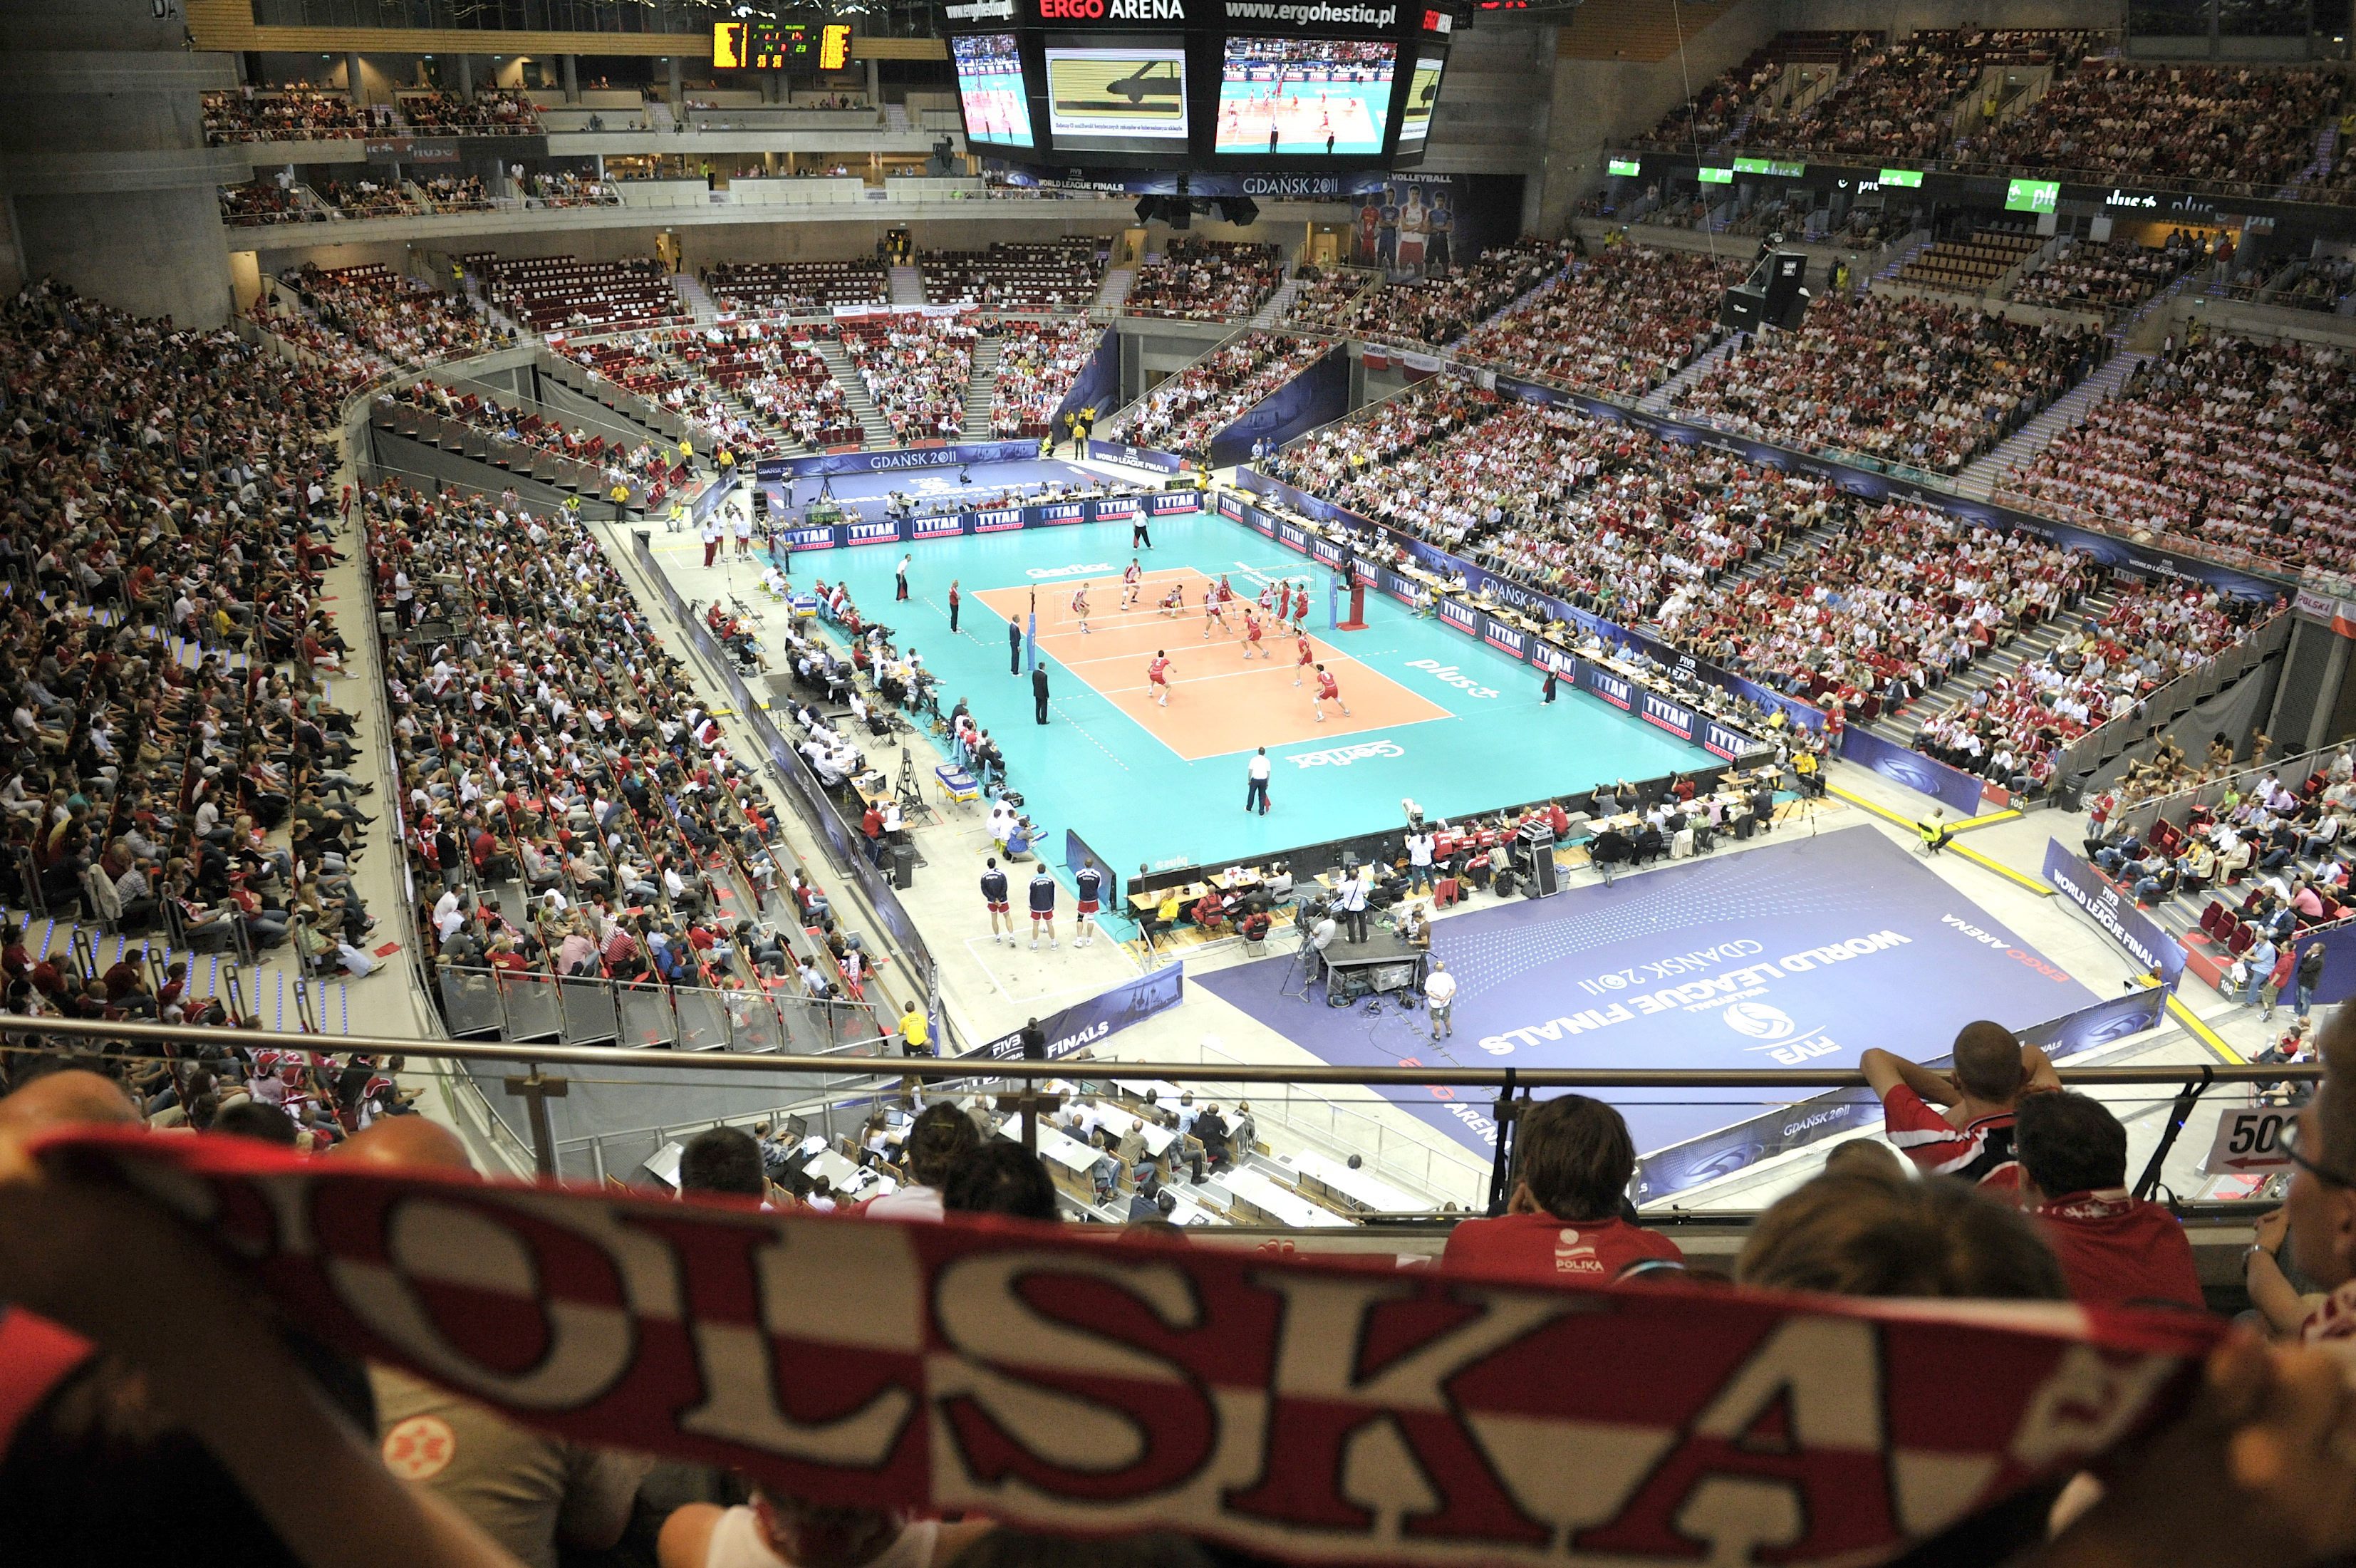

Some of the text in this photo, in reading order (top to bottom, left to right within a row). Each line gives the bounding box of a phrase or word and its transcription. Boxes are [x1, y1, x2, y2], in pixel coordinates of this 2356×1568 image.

[1040, 0, 1185, 19] ERGO ARENA
[1225, 1, 1397, 28] www.ergohestia.pl
[1038, 179, 1124, 192] WORLD LEAGUE FINALS
[1242, 175, 1339, 194] GDAŃSK 2011
[1391, 173, 1453, 183] VOLLEYBALL
[1445, 363, 1476, 378] SUBKOWY
[871, 451, 957, 469] GDAŃSK 2011
[1095, 452, 1169, 473] WORLD LEAGUE FINALS
[1100, 499, 1138, 514] TYTAN
[1156, 494, 1195, 509] TYTAN
[1221, 497, 1242, 517] TYTAN
[811, 514, 824, 523] 56
[916, 515, 959, 531] TYTAN
[978, 510, 1019, 526] TYTAN
[1040, 505, 1080, 520] TYTAN
[1252, 510, 1272, 531] TYTAN
[786, 529, 829, 544] TYTAN
[851, 521, 894, 539] TYTAN
[1282, 524, 1304, 546] TYTAN
[1315, 539, 1339, 562] TYTAN
[1354, 558, 1376, 580] YTAN
[2129, 559, 2152, 571] WORLD
[2152, 566, 2179, 578] LEAGUE
[2179, 573, 2204, 584] FINALS
[1443, 600, 1474, 625] TYTAN
[2298, 594, 2330, 613] POLSKA
[1488, 621, 1521, 649] TYTAN
[1536, 642, 1572, 674] TYN
[1679, 655, 1696, 668] FIVB
[1403, 658, 1477, 690] plus
[1591, 670, 1628, 701] TYTAN
[1646, 696, 1688, 729] TYTAN
[1285, 739, 1405, 769] Gerflor
[2009, 796, 2024, 809] 105
[2102, 886, 2119, 906] FIVB
[2054, 869, 2162, 969] WORLD LEAGUE FINALS
[1941, 913, 2070, 983] ERGO ARENA
[1576, 938, 1764, 997] GDAŃSK 2011
[1478, 930, 1914, 1056] WORLD LEAGUE FINALS
[2220, 978, 2234, 995] 106
[1683, 987, 1770, 1013] VOLLEYBALL
[992, 1034, 1022, 1056] FIVB
[1047, 1022, 1109, 1059] FINALS
[1770, 1034, 1843, 1066] FIVB
[2040, 1040, 2062, 1053] NALS
[1783, 1104, 1851, 1137] GDAŃSK 2011
[1555, 1259, 1604, 1272] POLSKA
